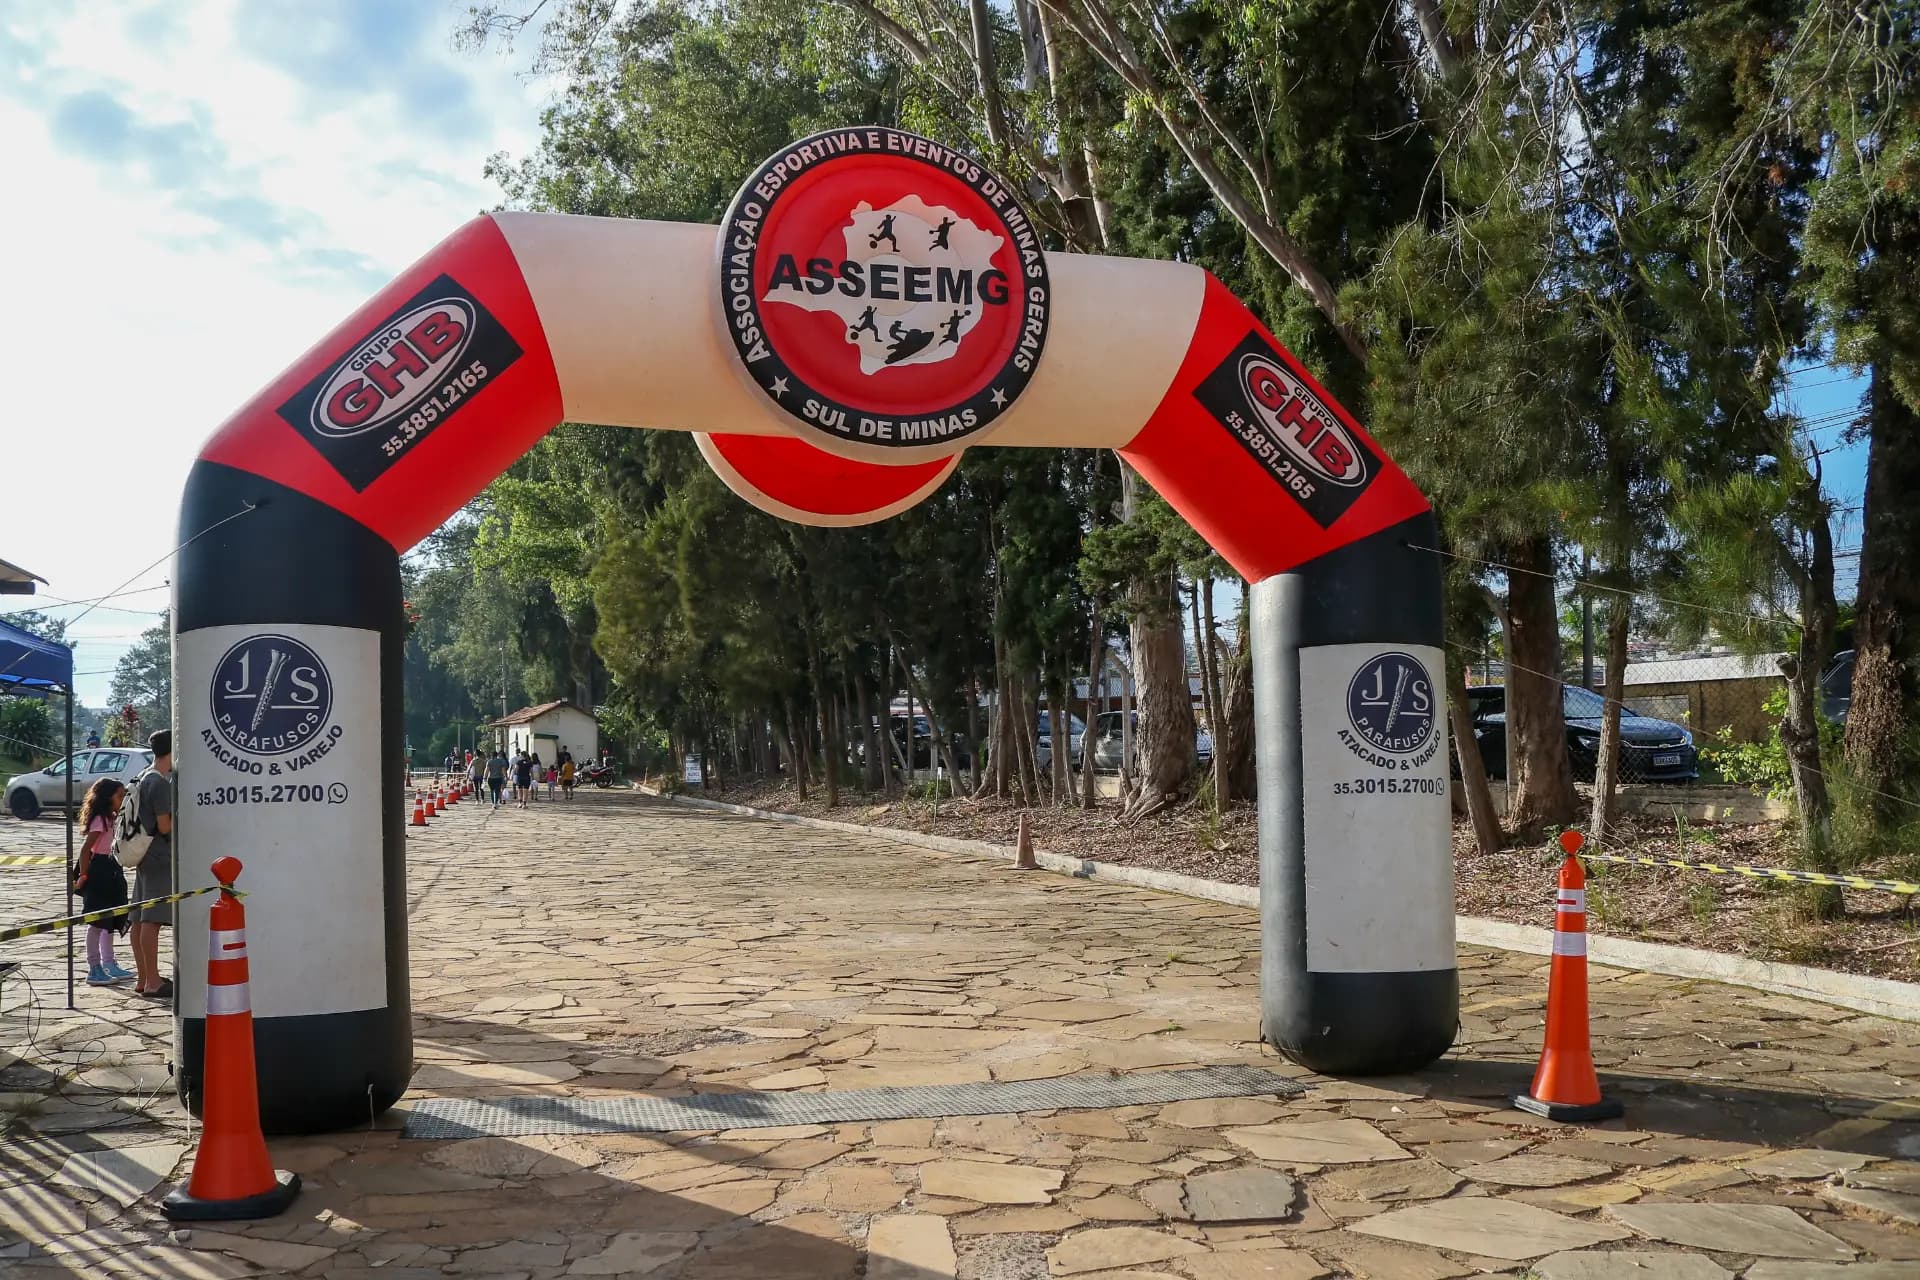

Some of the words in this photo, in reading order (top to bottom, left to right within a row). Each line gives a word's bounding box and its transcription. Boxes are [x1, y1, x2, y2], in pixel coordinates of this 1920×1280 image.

[867, 132, 880, 149] E
[887, 133, 982, 183] EVENTOS
[754, 132, 862, 200] ESPORTIVA
[980, 178, 1010, 208] DE
[1003, 206, 1044, 278] MINAS
[730, 202, 771, 364] ASSOCIAÇÃO
[769, 253, 1009, 306] ASSEEMG
[351, 328, 402, 372] GRUPO
[1013, 286, 1046, 374] GERAIS
[327, 311, 465, 428] GHB
[381, 360, 488, 458] 35.3851.2165
[802, 398, 851, 433] SUL
[858, 417, 893, 440] DE
[900, 407, 978, 441] MINAS
[1247, 366, 1353, 478] GHB
[1294, 386, 1334, 428] GRUPO
[1225, 411, 1315, 500] 35.3851.2165
[201, 728, 263, 776] ATACADO
[269, 762, 282, 776] &
[285, 724, 343, 773] VAREJO
[218, 711, 319, 750] PARAFUSOS
[1337, 729, 1397, 770] ATACADO
[1401, 759, 1410, 771] &
[1411, 729, 1442, 768] VAREJO
[1357, 716, 1430, 748] PARAFUSOS
[197, 784, 324, 807] 35.3015.2700
[1334, 778, 1434, 795] 35.3015.2700
